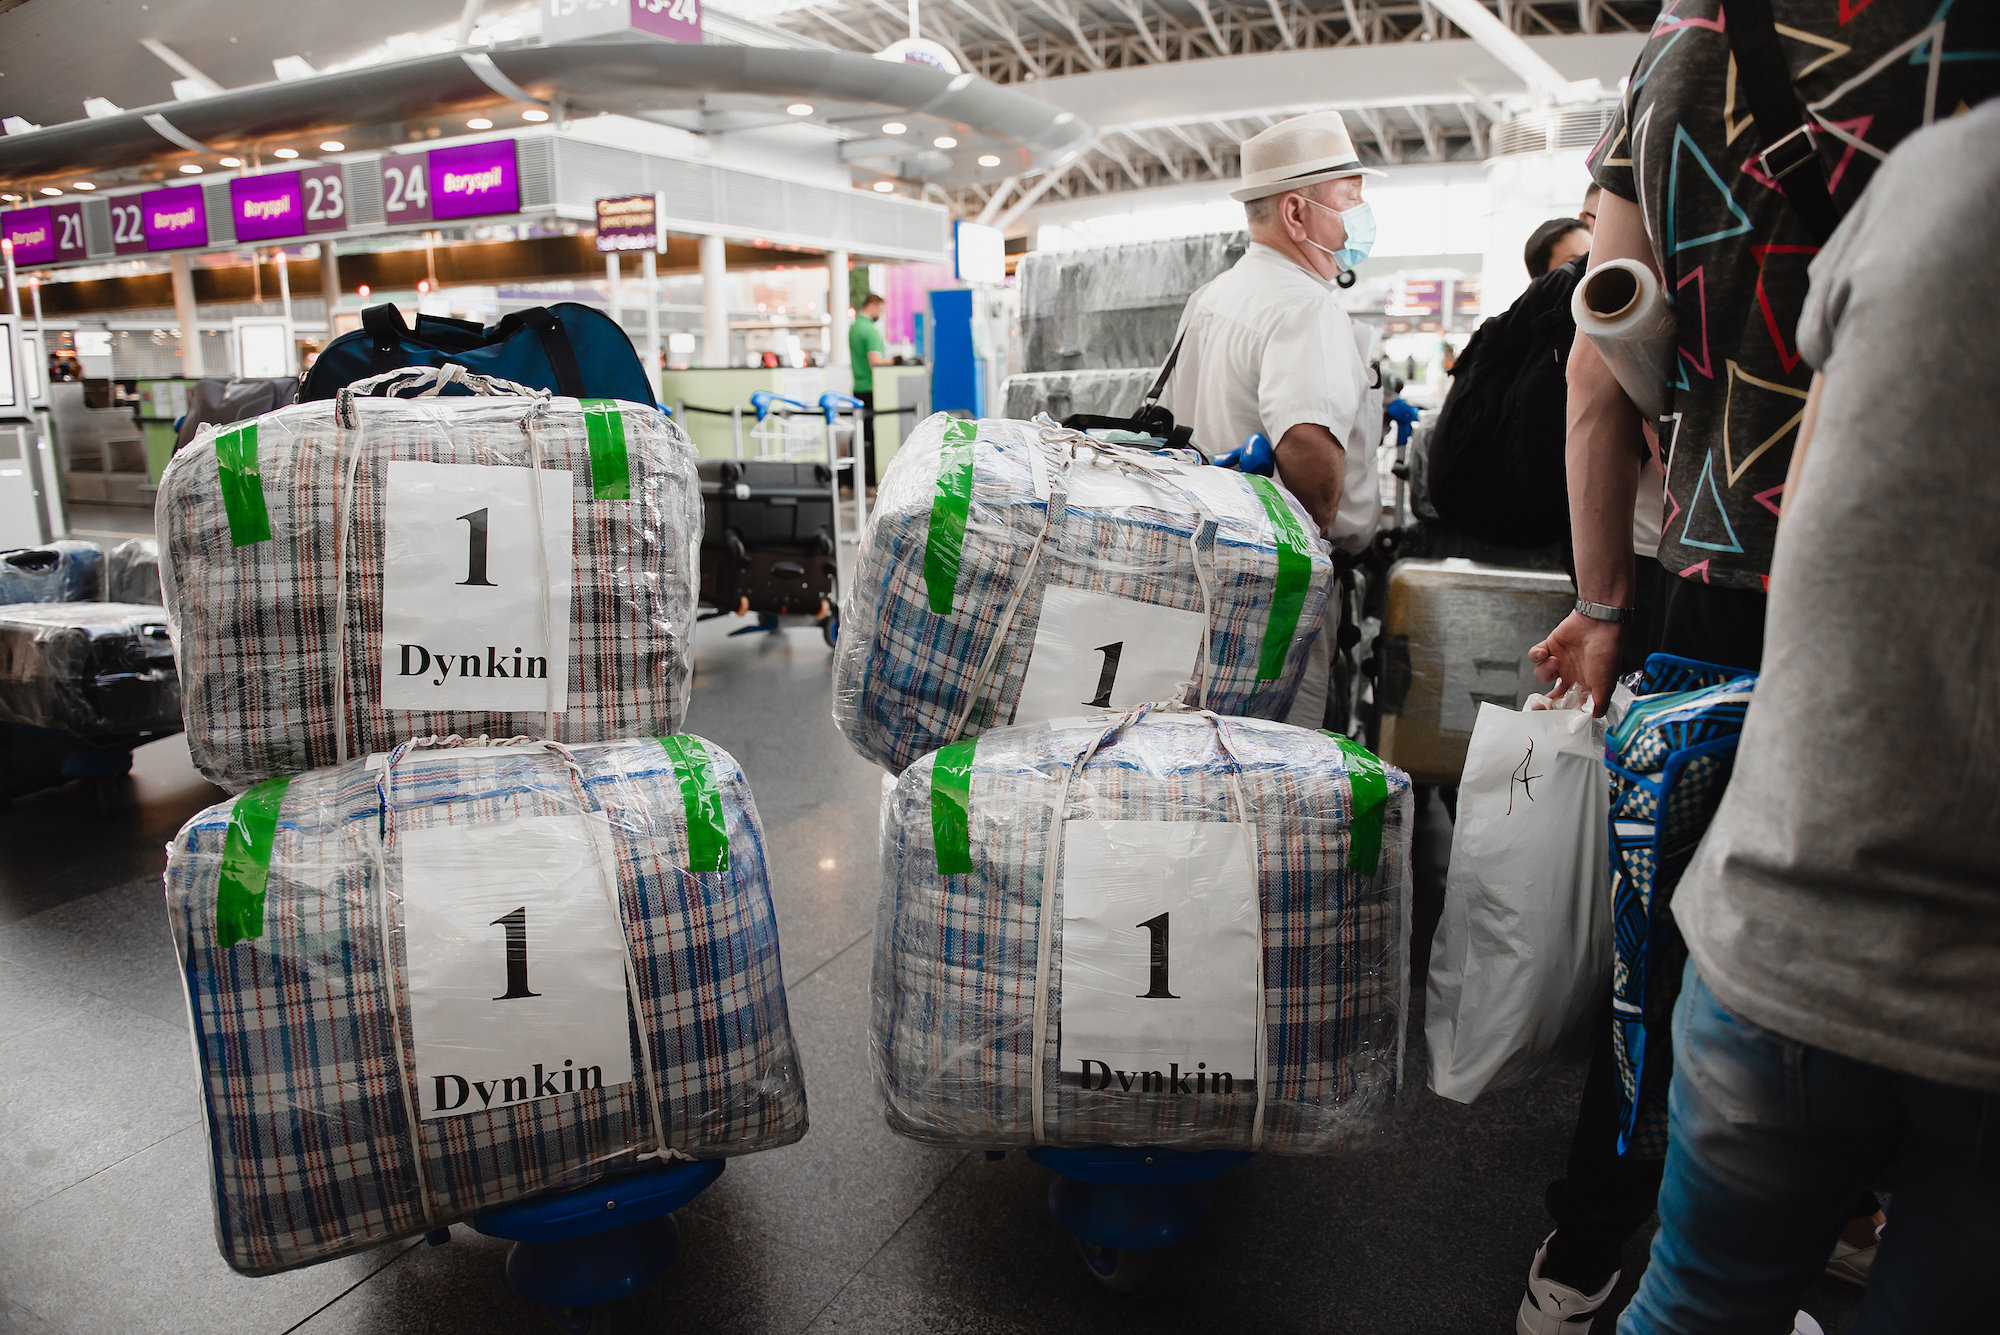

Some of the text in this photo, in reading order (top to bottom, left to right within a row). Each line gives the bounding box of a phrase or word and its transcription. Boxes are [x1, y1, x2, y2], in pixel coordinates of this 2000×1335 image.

[304, 175, 345, 221] 23
[384, 164, 428, 213] 24
[57, 213, 84, 250] 21
[111, 204, 145, 244] 22
[455, 507, 499, 587] 1
[396, 643, 548, 687] Dynkin
[1081, 641, 1123, 708] 1
[489, 906, 542, 1000] 1
[1135, 912, 1182, 999] 1
[430, 1059, 605, 1112] Dynkin
[1077, 1058, 1234, 1095] Dynkin
